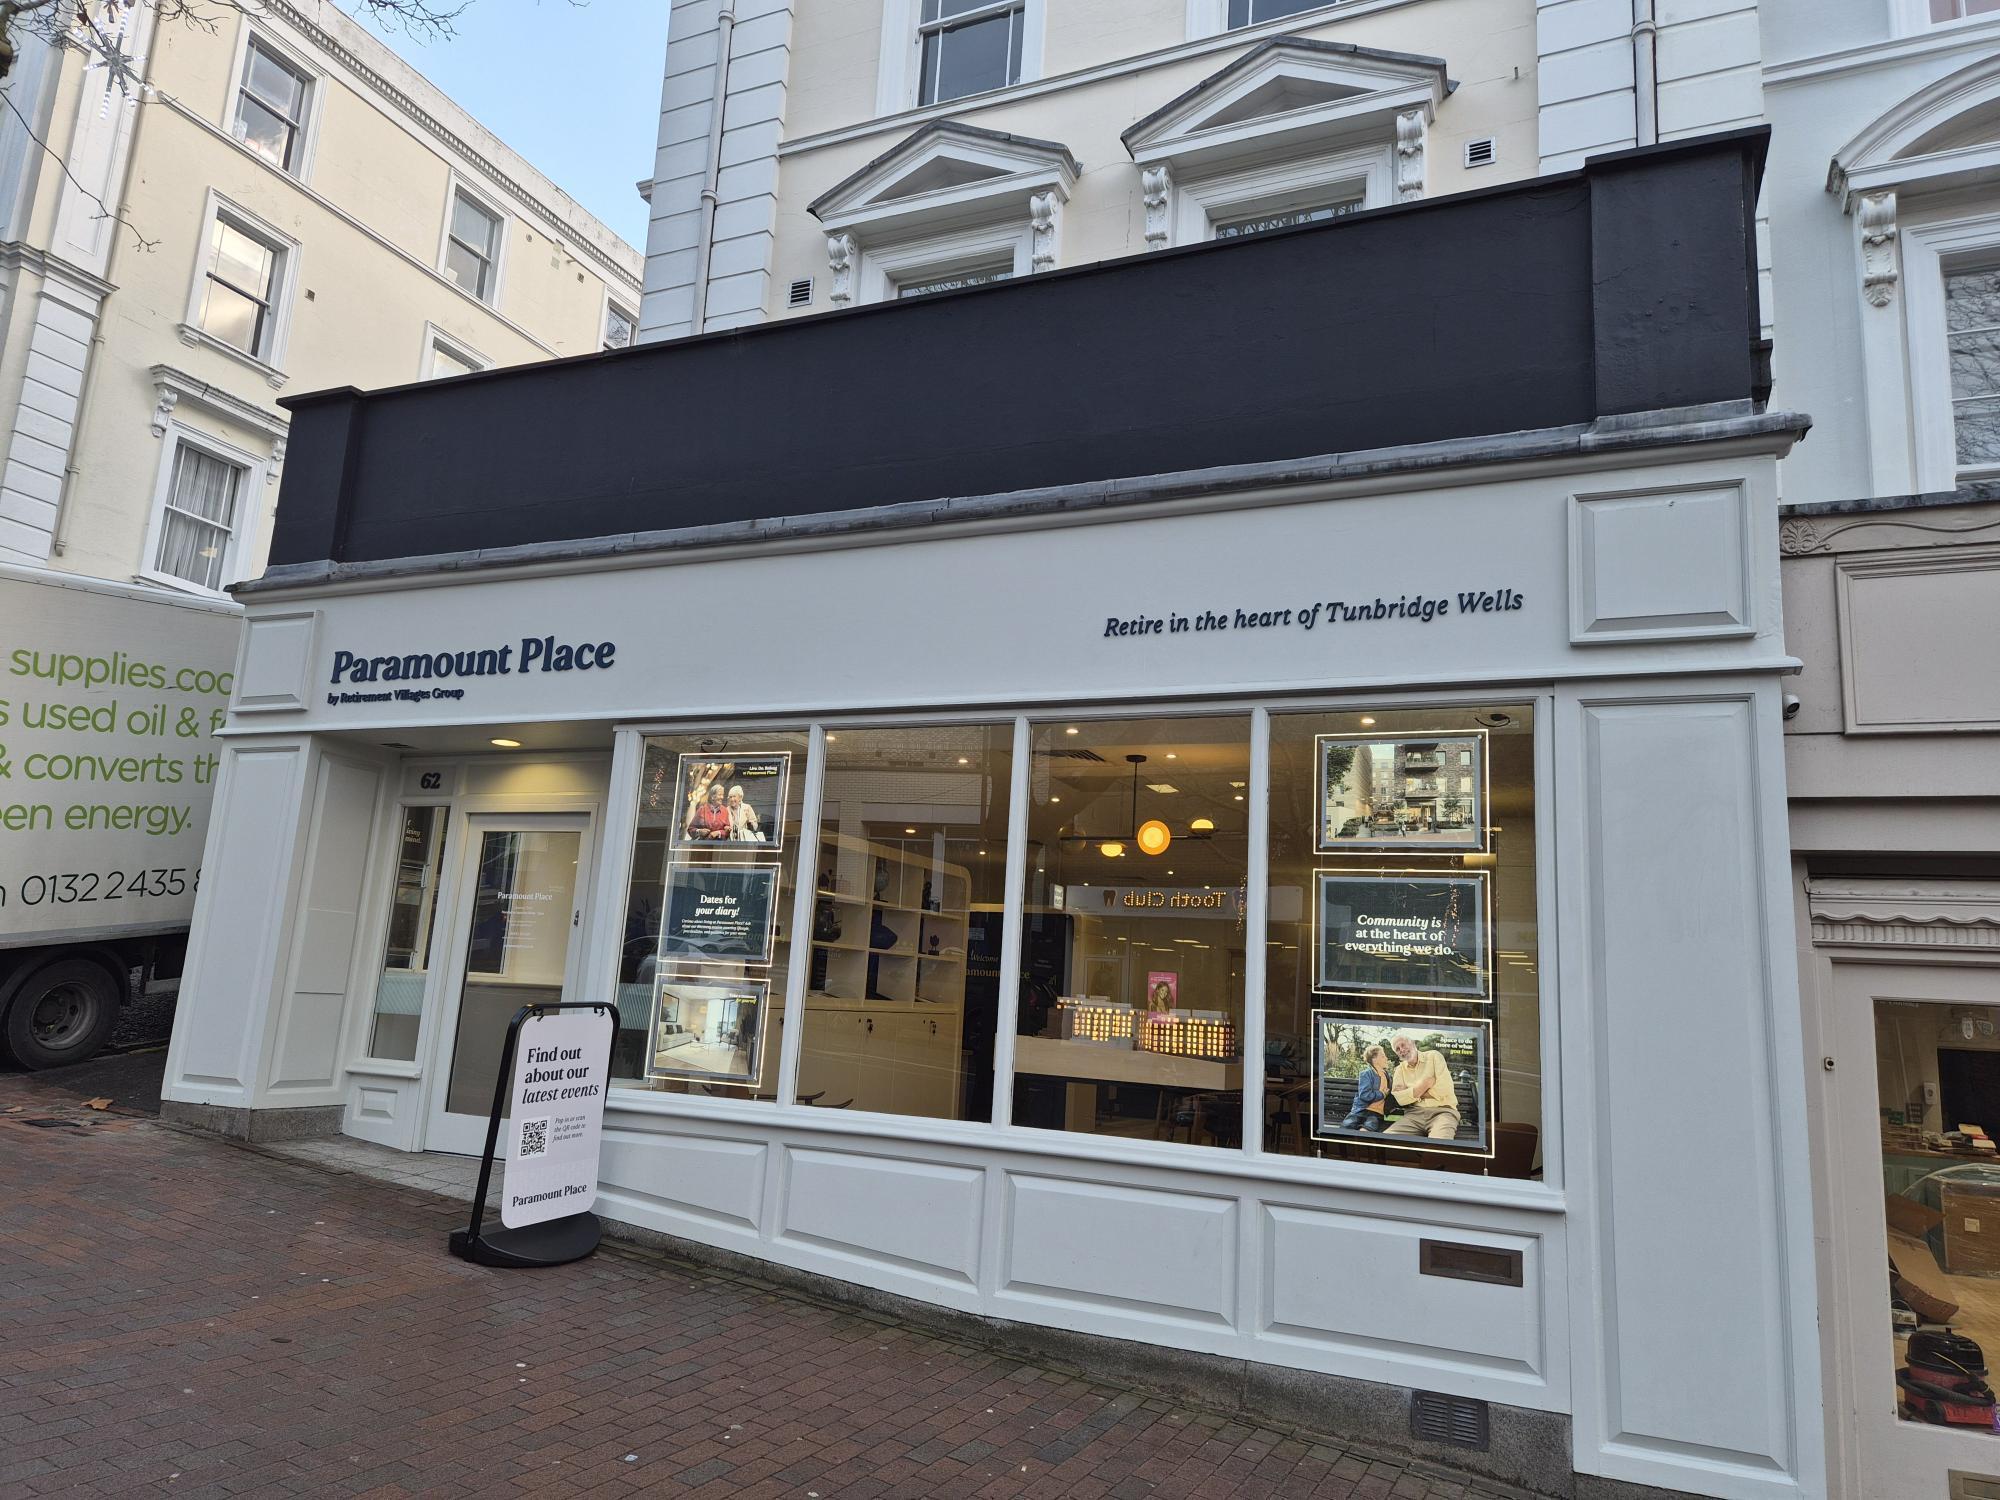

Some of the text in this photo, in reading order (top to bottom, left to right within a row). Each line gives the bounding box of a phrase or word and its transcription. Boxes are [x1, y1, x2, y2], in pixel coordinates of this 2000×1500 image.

[1103, 588, 1524, 638] Retire in the heart of Tunbridge Wells
[329, 635, 616, 684] Paramount Place
[9, 649, 166, 690] supplies
[327, 687, 465, 706] by Retirement Villages Group
[22, 699, 117, 733] used
[127, 703, 167, 736] oil
[174, 706, 200, 738] &
[24, 753, 184, 784] converts
[420, 772, 441, 789] 62
[0, 804, 193, 836] en energy.
[497, 891, 553, 902] Paramount Place
[700, 895, 738, 905] Dates for
[694, 906, 740, 918] your diary!
[1357, 914, 1443, 931] Community is
[1355, 927, 1446, 942] at the heart of
[1344, 941, 1455, 957] everything we do.
[526, 1047, 582, 1064] Find out
[524, 1066, 590, 1084] about our
[522, 1084, 600, 1104] latest events
[512, 1184, 588, 1208] Paramount Place
